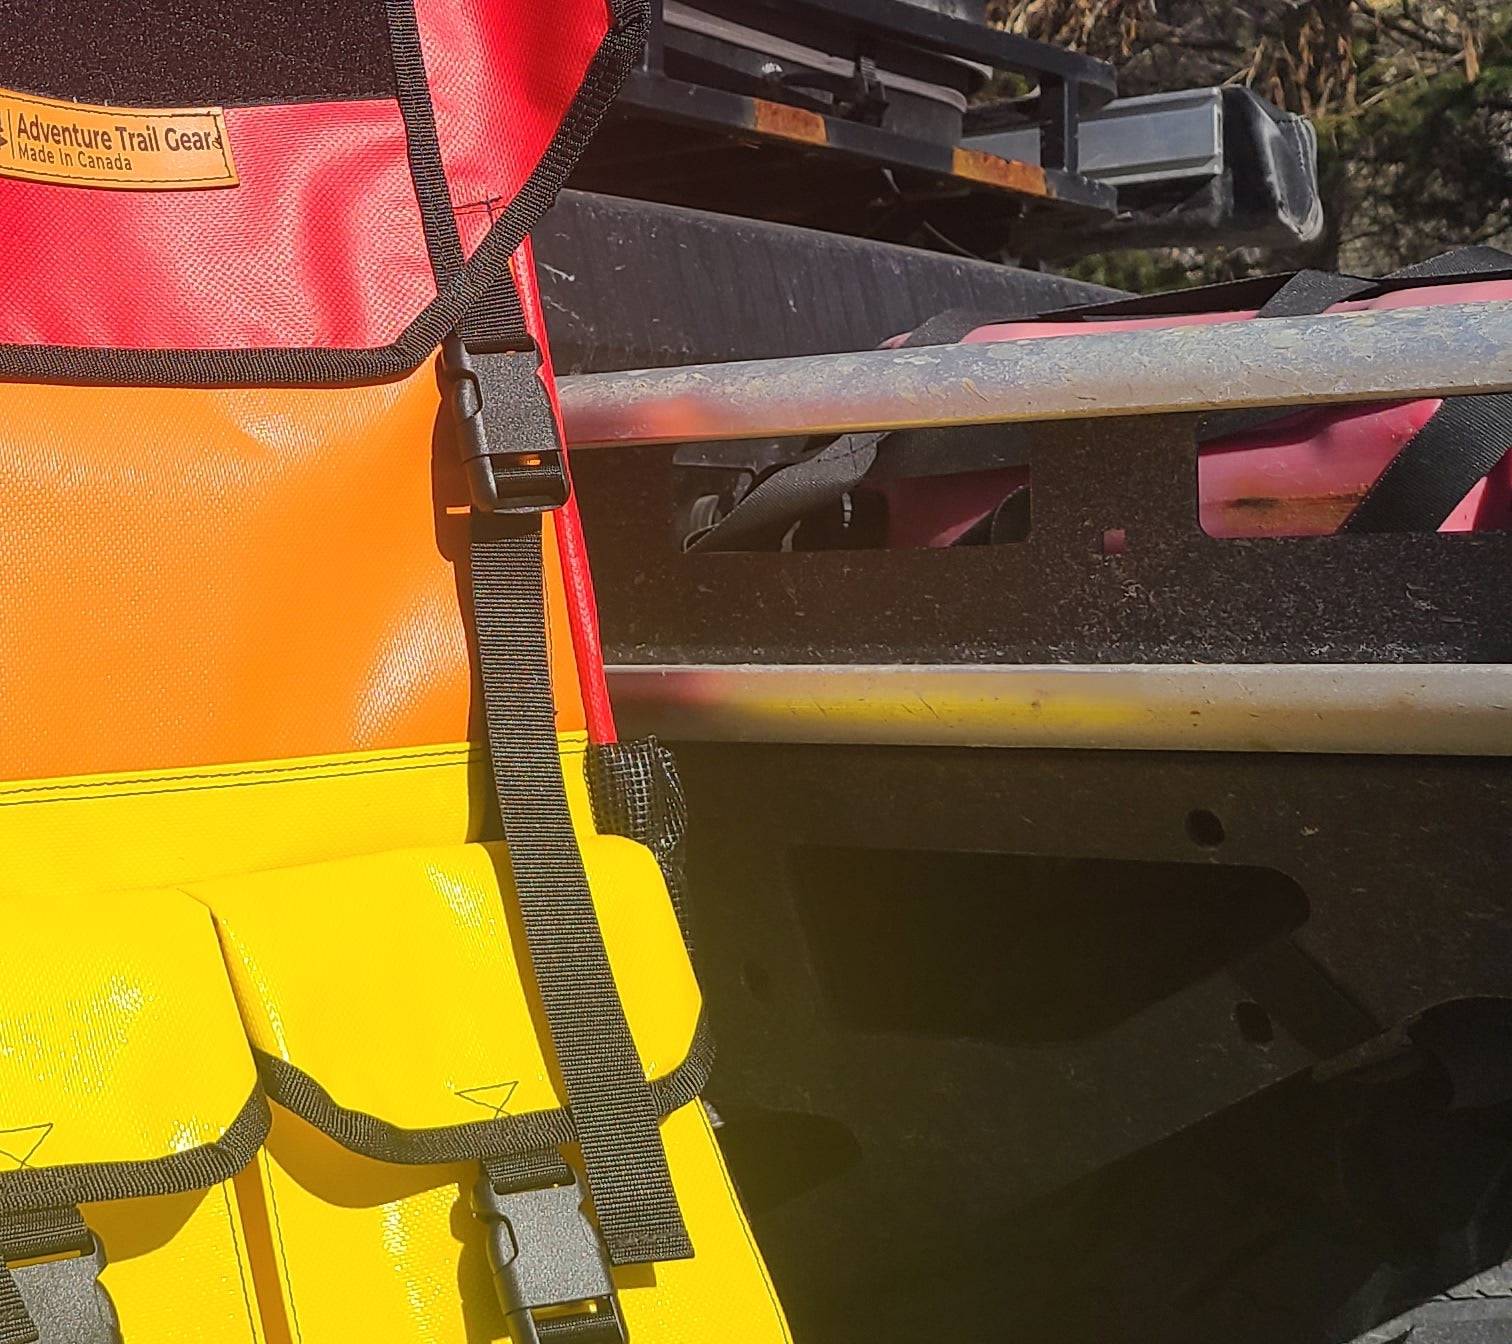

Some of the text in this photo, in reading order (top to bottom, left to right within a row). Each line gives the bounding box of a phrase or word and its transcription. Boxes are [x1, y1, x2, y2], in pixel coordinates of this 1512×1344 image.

[17, 113, 212, 152] Adventure Trail Gear
[18, 142, 55, 164] Made
[78, 152, 132, 170] Canada
